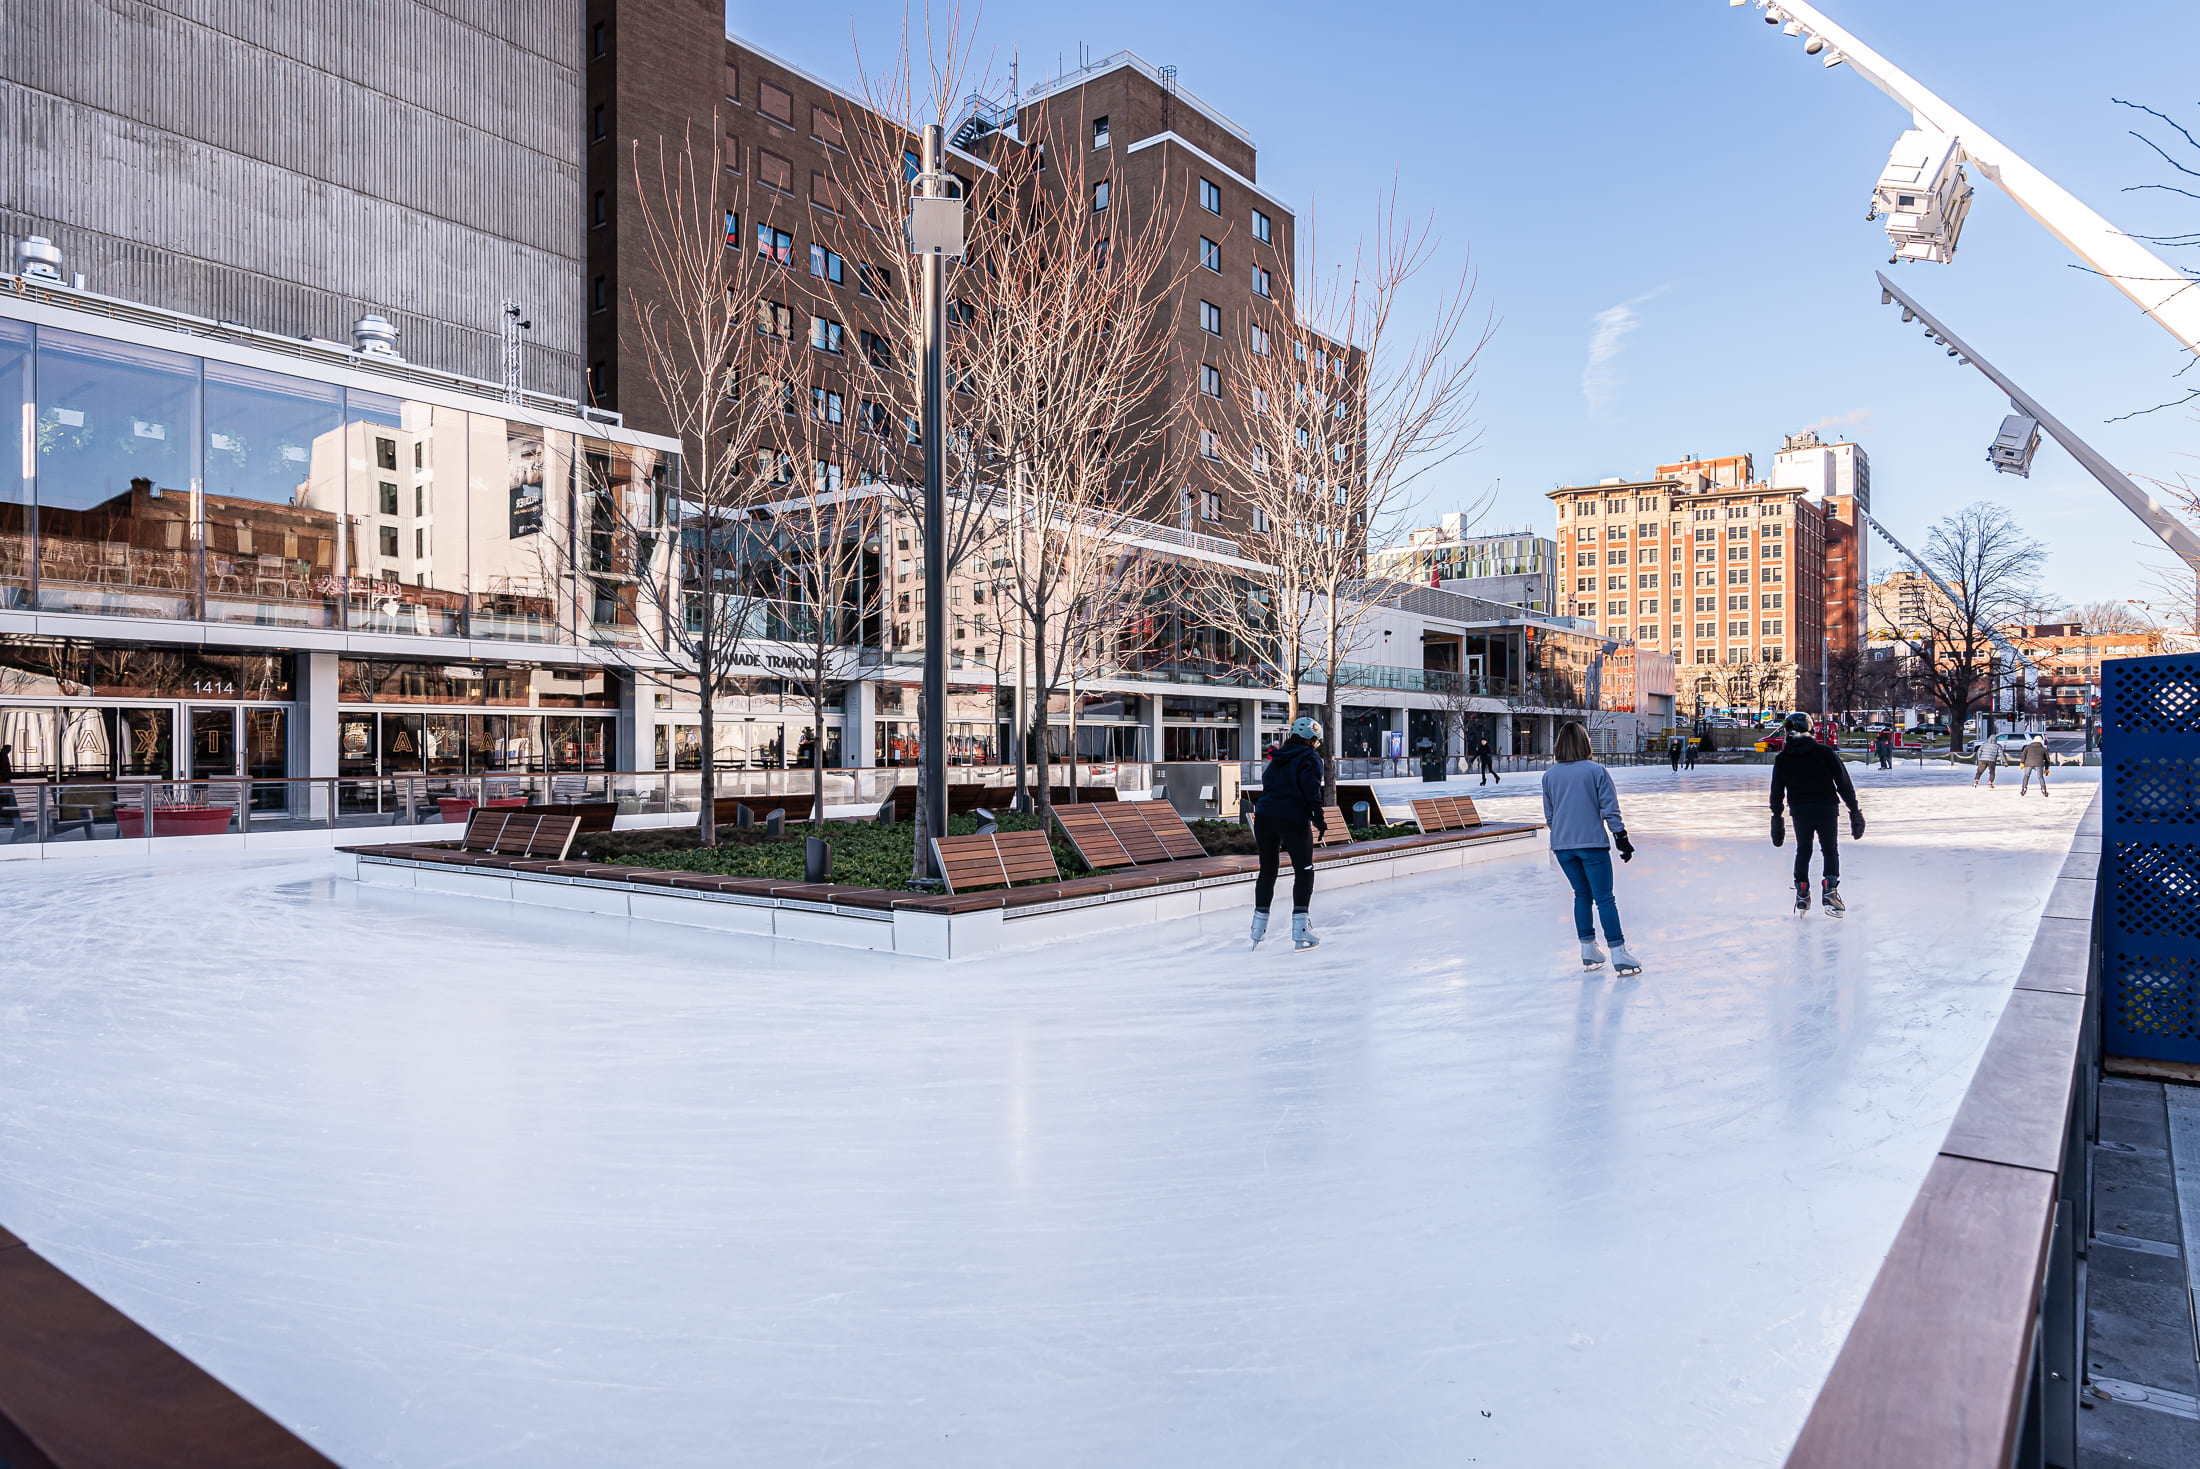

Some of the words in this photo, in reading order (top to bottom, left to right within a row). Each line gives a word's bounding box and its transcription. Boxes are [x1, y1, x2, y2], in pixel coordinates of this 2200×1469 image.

[692, 650, 761, 667] ELANADE
[765, 655, 834, 671] TRANQUILE
[193, 680, 235, 694] 1414
